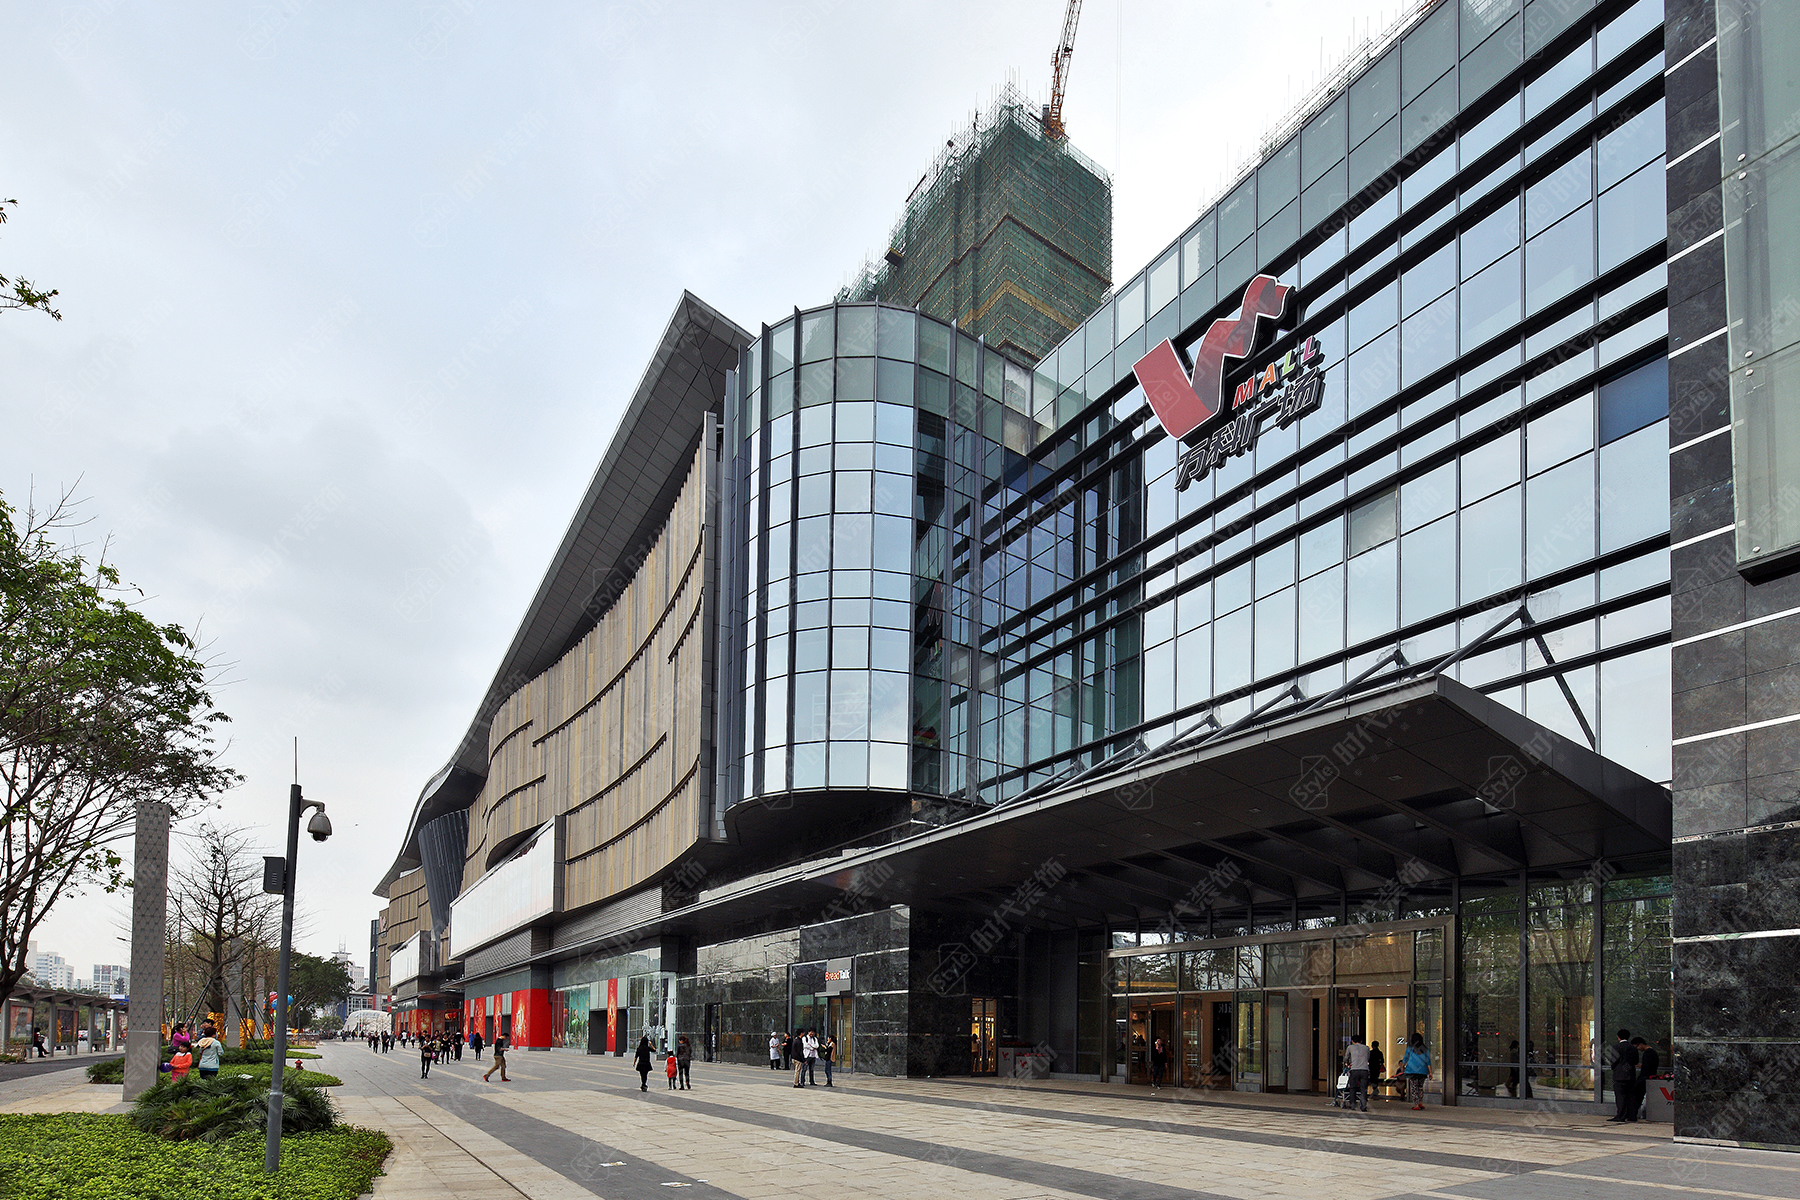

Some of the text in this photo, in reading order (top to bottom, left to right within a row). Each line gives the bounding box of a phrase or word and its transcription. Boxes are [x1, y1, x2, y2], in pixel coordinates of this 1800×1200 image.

[1232, 335, 1321, 411] MALL
[1174, 367, 1322, 490] 万科广场
